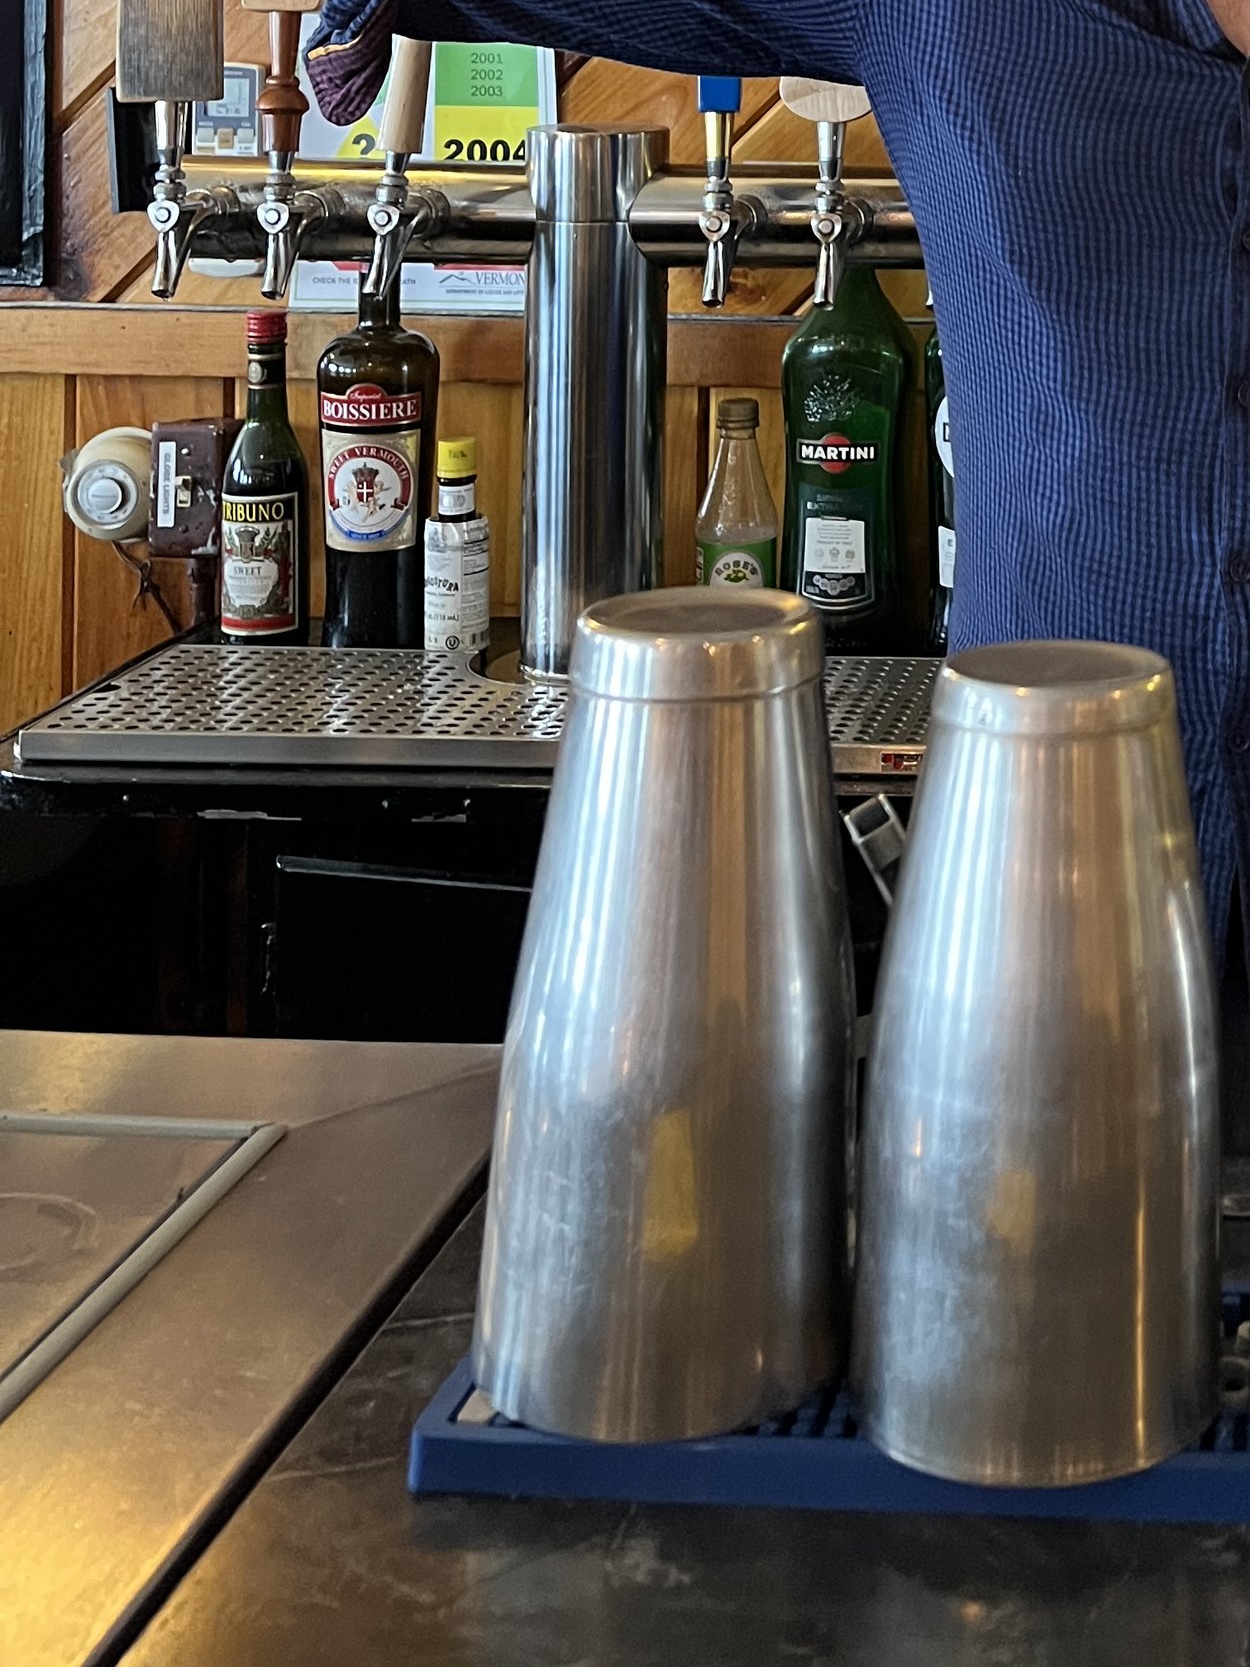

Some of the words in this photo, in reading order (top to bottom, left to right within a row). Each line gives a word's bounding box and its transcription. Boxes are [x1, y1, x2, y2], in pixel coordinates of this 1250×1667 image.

[470, 52, 504, 65] 2001
[470, 69, 504, 82] 2002
[470, 85, 504, 98] 2003
[312, 276, 337, 285] CHECK
[338, 276, 351, 284] THE
[475, 270, 527, 286] VERMON
[323, 398, 417, 421] BOISSIERE
[800, 444, 875, 461] MARTINI
[328, 449, 350, 480] SWEET
[353, 445, 411, 481] VERMOUTH
[223, 500, 286, 522] TRIBUNO
[233, 565, 263, 576] SWEET
[714, 559, 759, 577] ROSE'S
